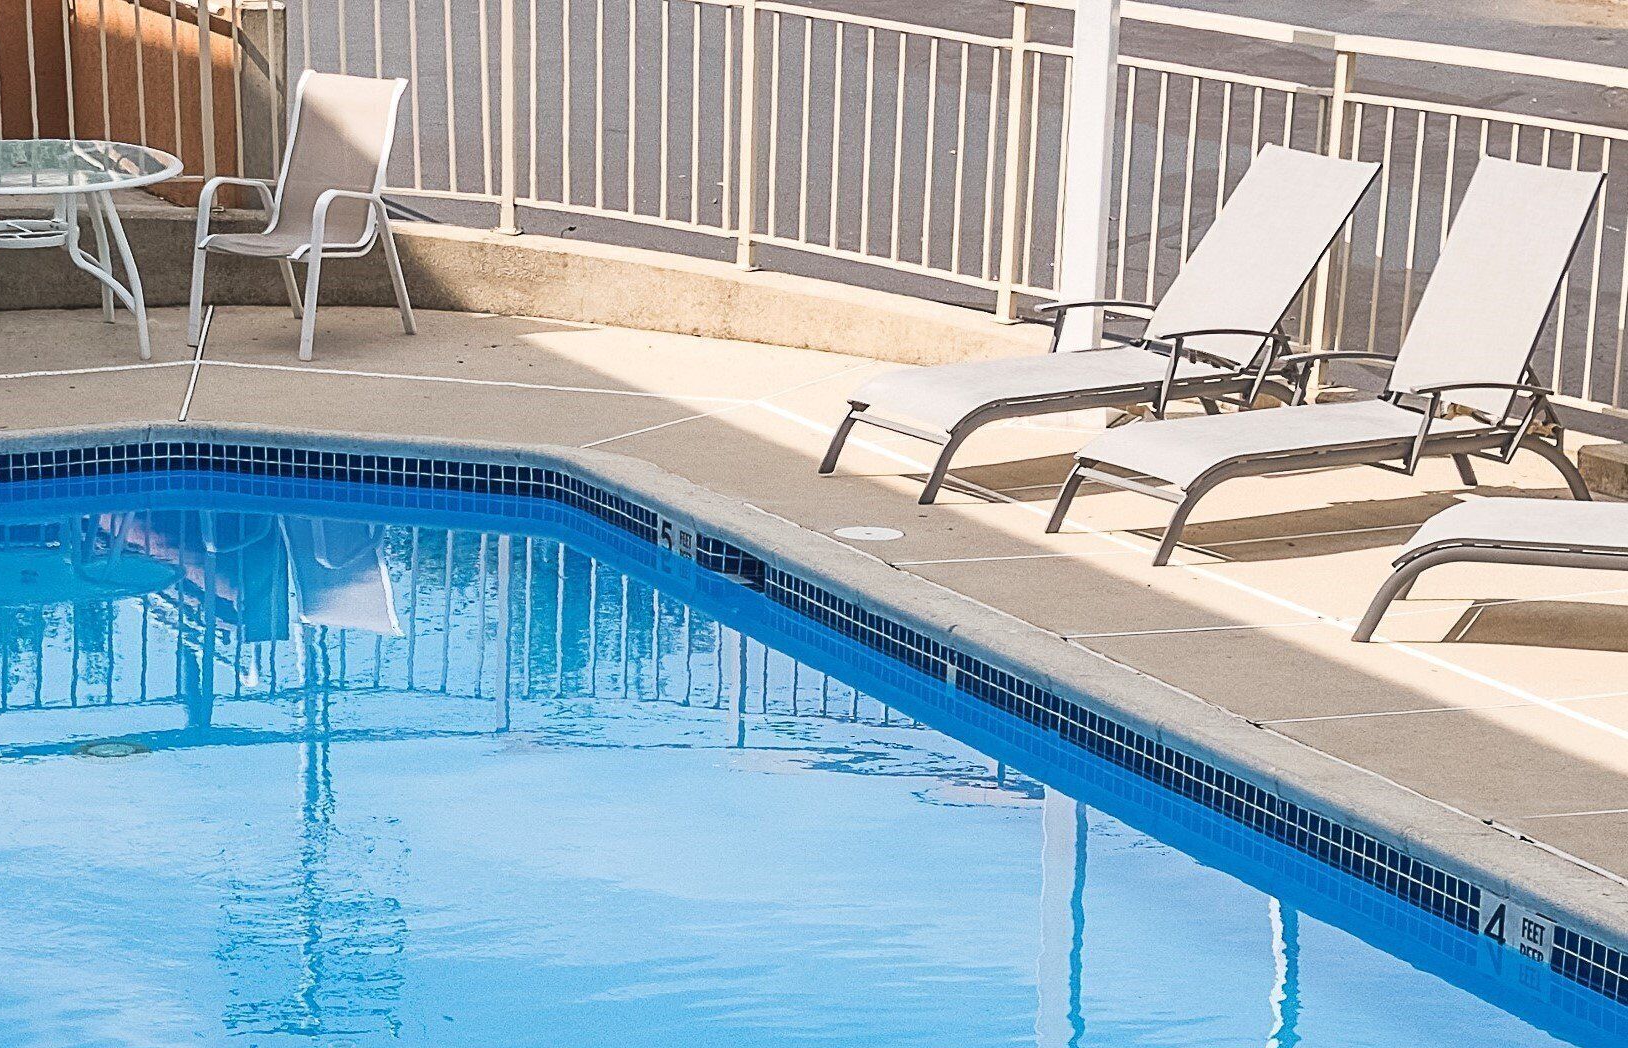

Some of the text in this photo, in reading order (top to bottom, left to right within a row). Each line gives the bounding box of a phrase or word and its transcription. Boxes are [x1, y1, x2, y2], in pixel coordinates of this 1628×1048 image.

[661, 520, 673, 552] 5
[1484, 903, 1546, 946] 4 FEET
